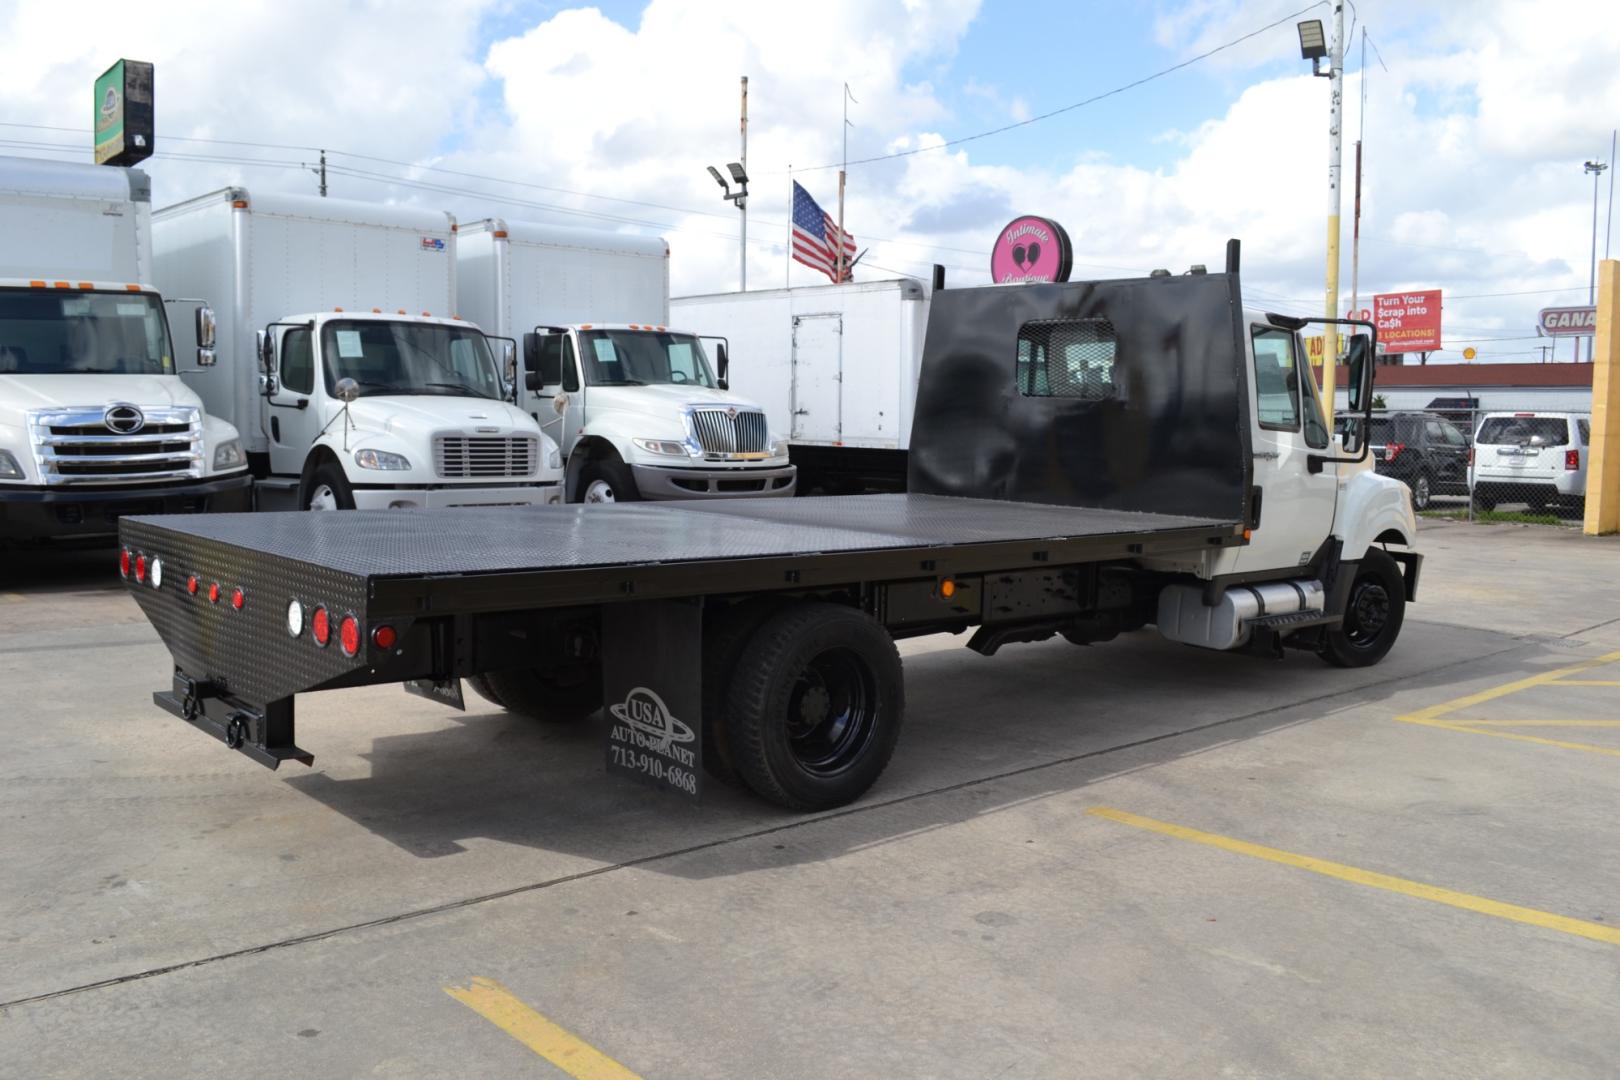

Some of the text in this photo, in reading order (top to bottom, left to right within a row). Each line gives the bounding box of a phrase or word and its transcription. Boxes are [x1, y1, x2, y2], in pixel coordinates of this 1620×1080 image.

[1006, 223, 1049, 244] Intimate
[1376, 295, 1425, 306] Turn Your
[1378, 317, 1402, 329] Ca$h
[1384, 329, 1435, 339] LOCATIONS!
[631, 699, 665, 728] USA
[611, 745, 696, 795] 713-910-6868
